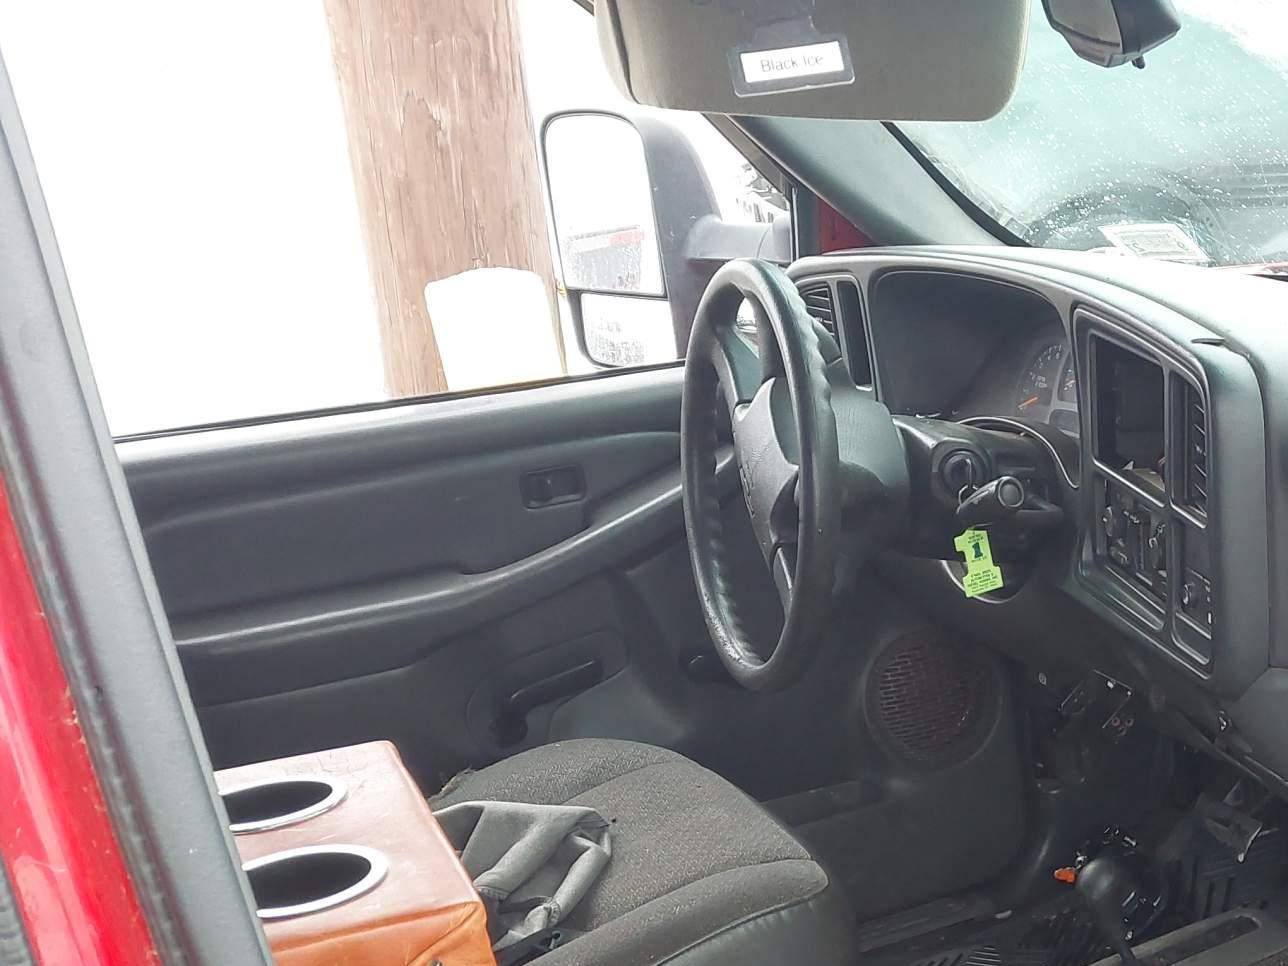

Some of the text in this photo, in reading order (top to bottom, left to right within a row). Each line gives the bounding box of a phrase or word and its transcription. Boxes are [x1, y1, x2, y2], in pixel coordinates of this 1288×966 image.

[761, 55, 824, 73] Black Ice
[972, 542, 983, 558] 1
